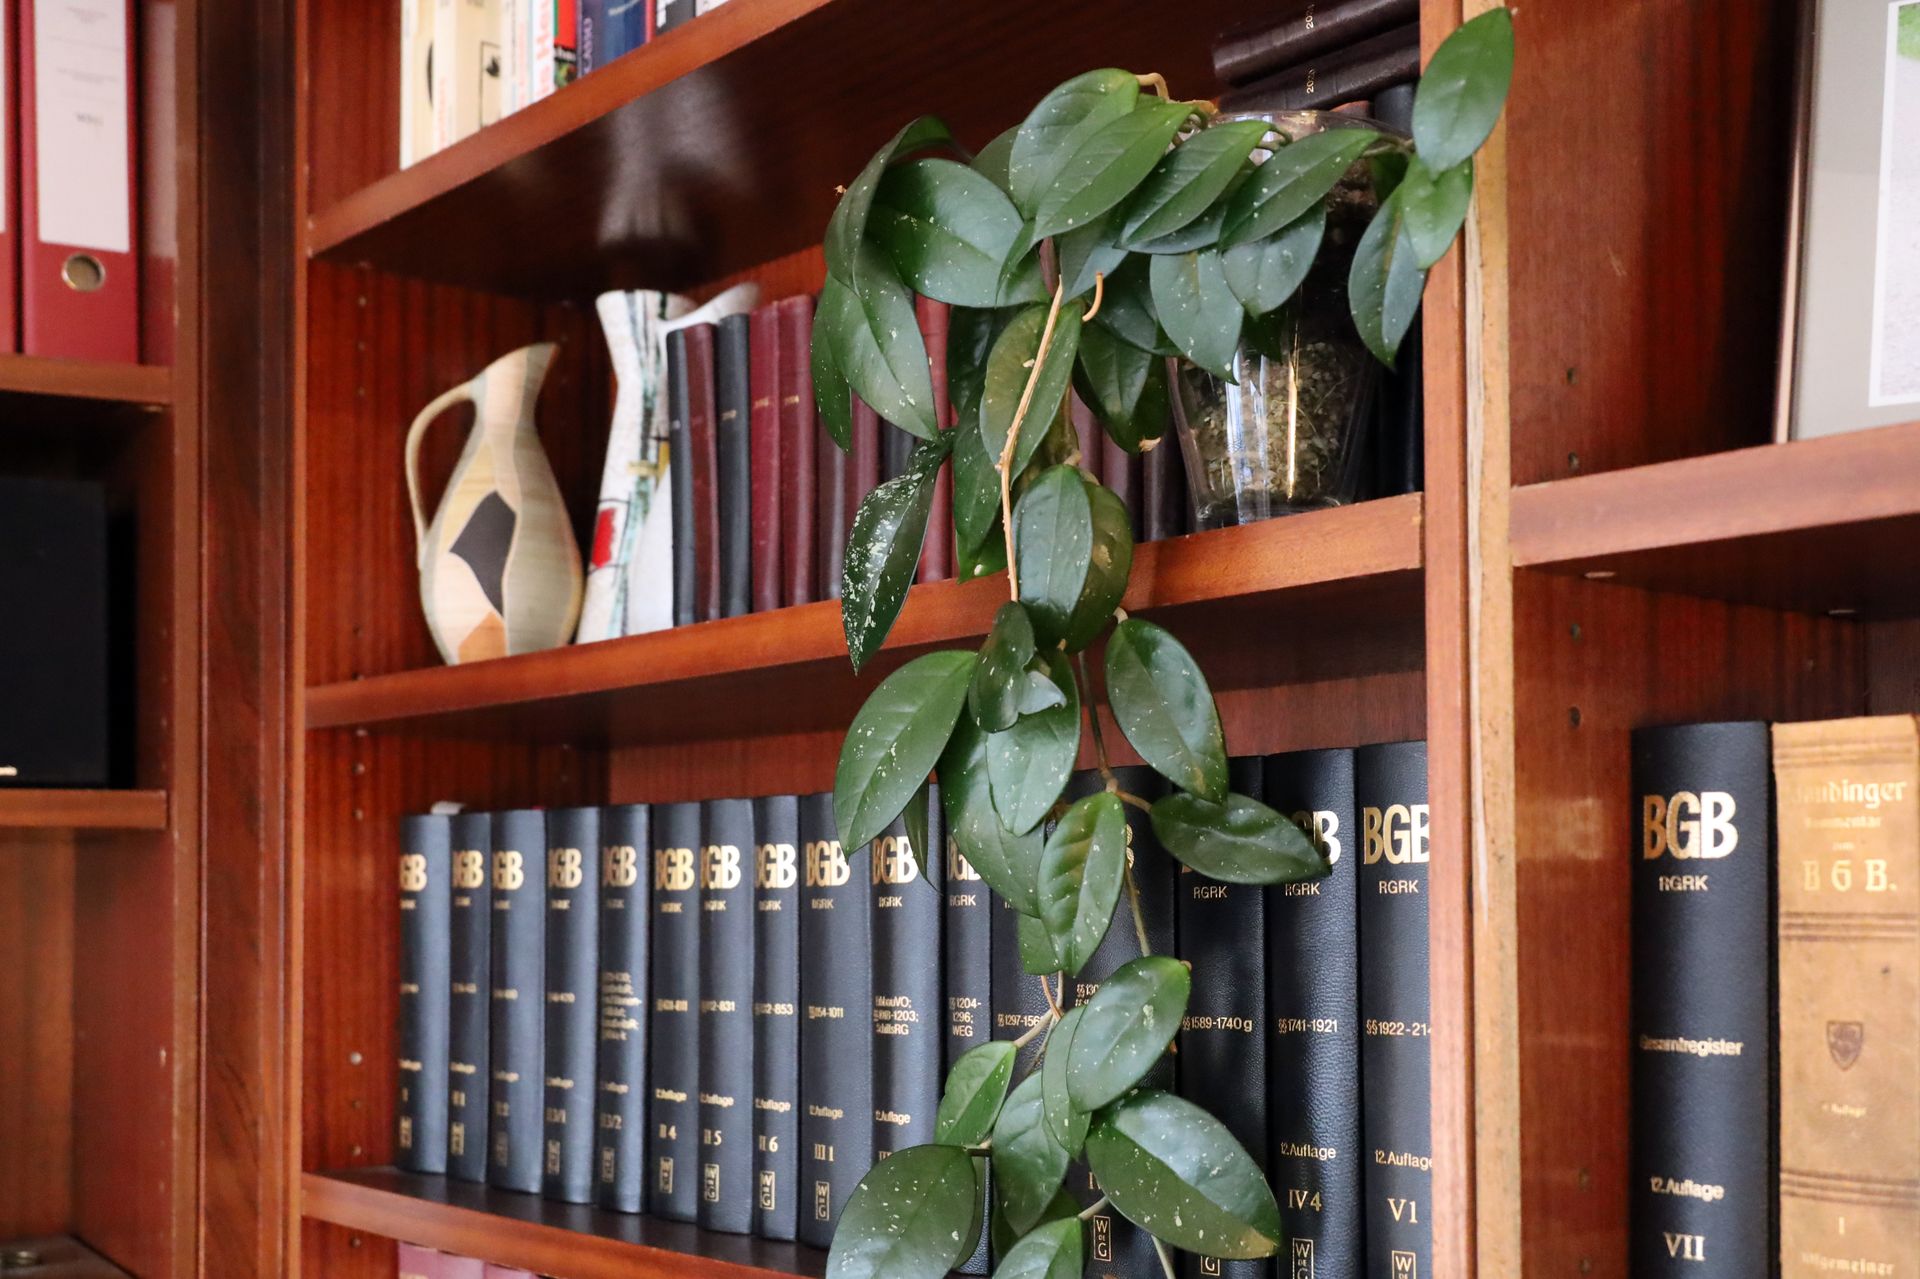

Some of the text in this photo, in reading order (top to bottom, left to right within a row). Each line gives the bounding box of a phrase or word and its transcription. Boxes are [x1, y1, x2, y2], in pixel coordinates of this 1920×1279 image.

[1305, 4, 1314, 29] 20
[1306, 69, 1315, 94] 20
[1363, 804, 1430, 865] BGB
[1643, 791, 1738, 860] BGB
[400, 853, 427, 892] GB
[492, 850, 524, 890] GB
[755, 843, 797, 889] BGB
[806, 840, 850, 887] BGB
[872, 836, 919, 885] BGB
[1193, 886, 1228, 900] RGRK
[1285, 882, 1320, 897] RGRK
[1379, 880, 1419, 894] RGRK
[1658, 875, 1708, 892] RGRK
[952, 1025, 974, 1038] WEG
[997, 1013, 1043, 1027] §§1297-156
[1278, 1018, 1338, 1034] §§1741-1921
[1664, 1232, 1706, 1262] VII
